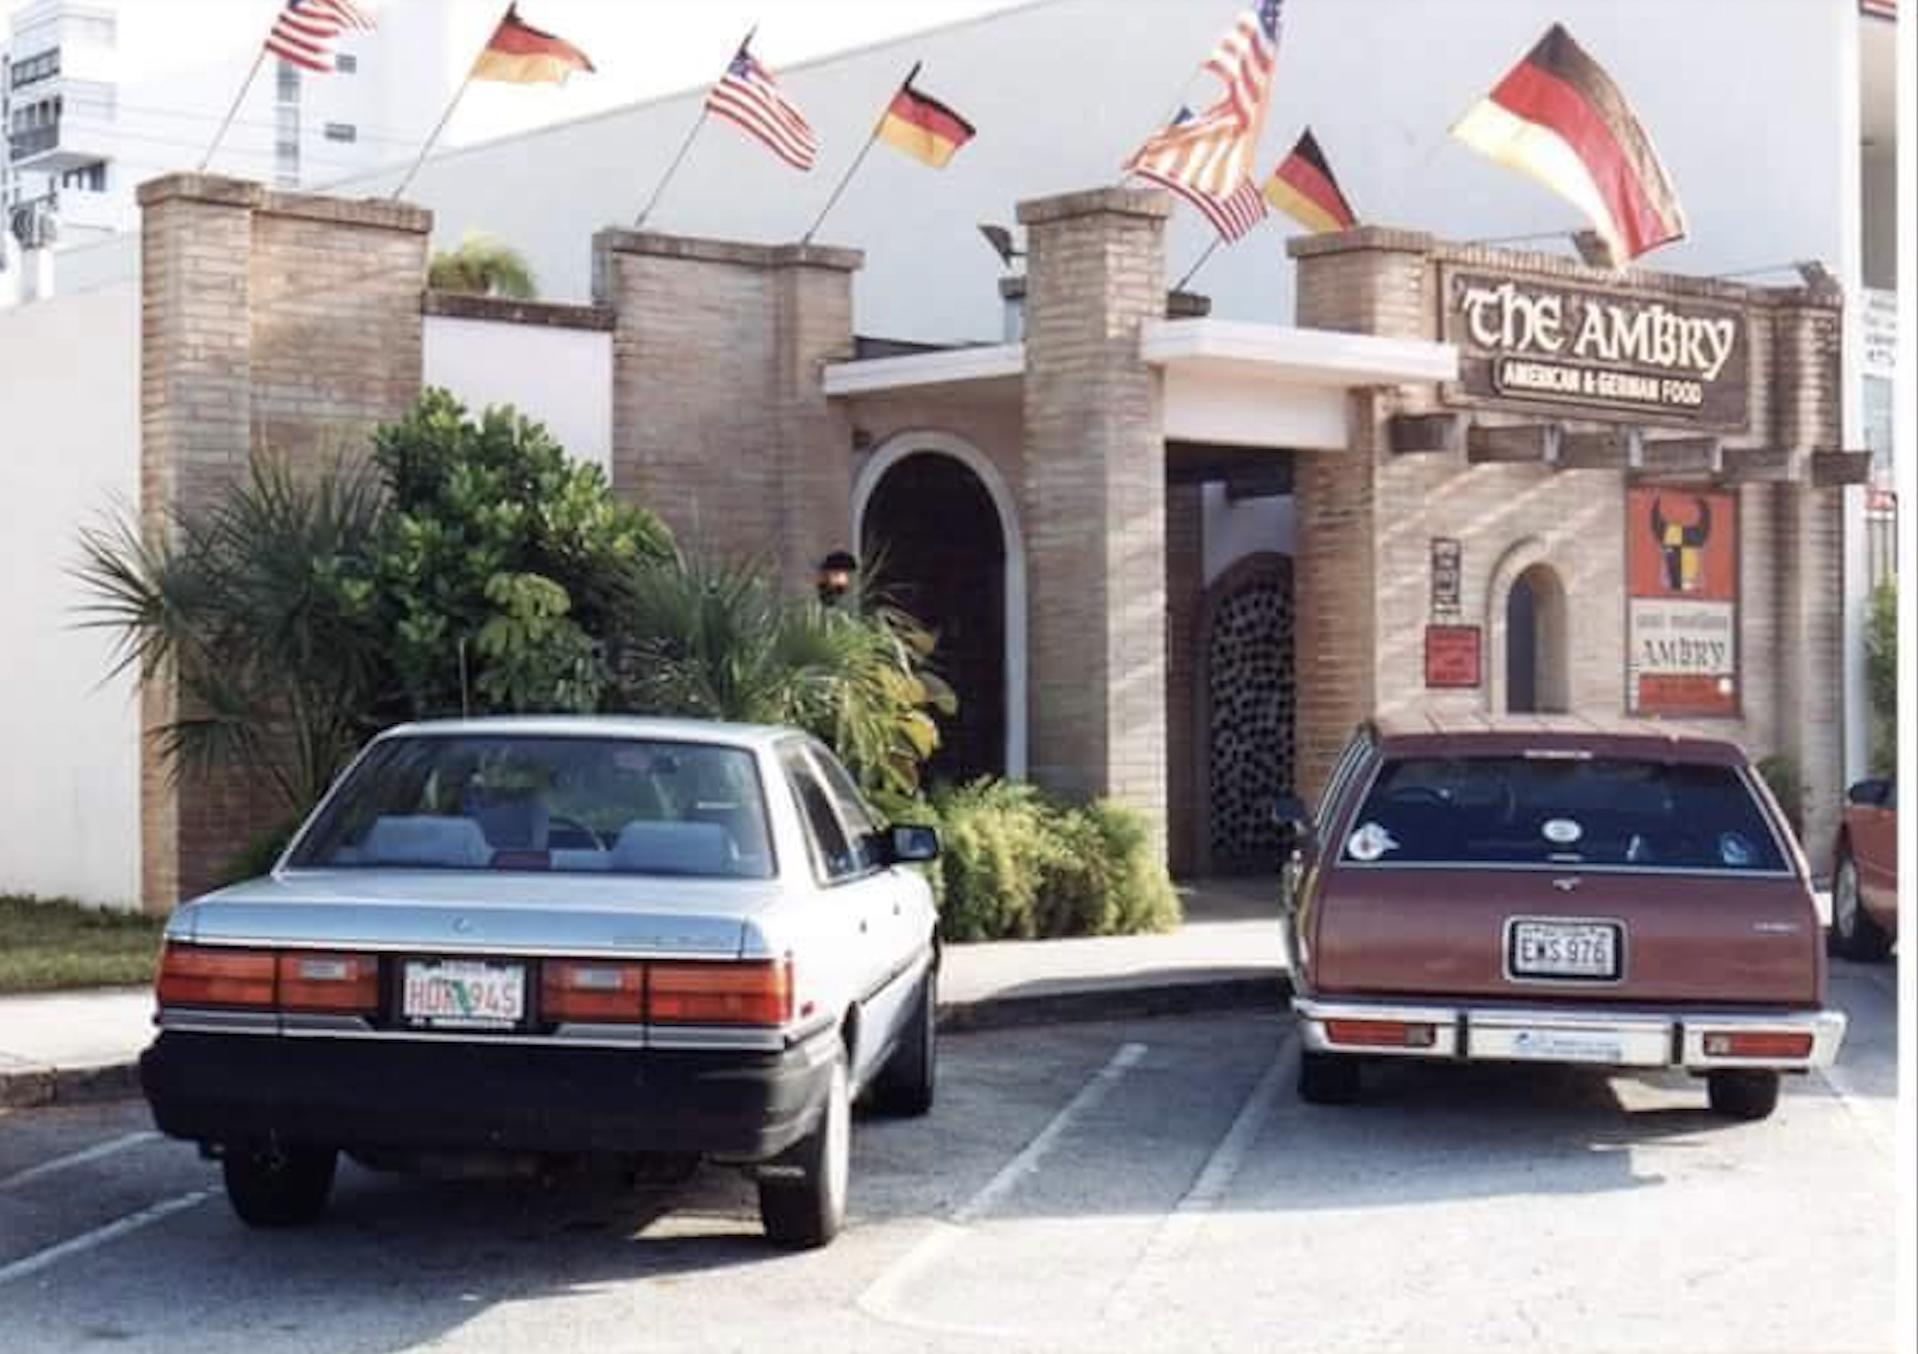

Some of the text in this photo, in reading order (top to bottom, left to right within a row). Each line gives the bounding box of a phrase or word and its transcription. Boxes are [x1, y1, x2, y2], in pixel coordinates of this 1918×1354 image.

[1575, 304, 1734, 380] AMBRY
[1503, 361, 1703, 405] AMERICAN & GERMAN FOOD
[1641, 637, 1726, 669] AMBRY
[1566, 938, 1607, 964] 976
